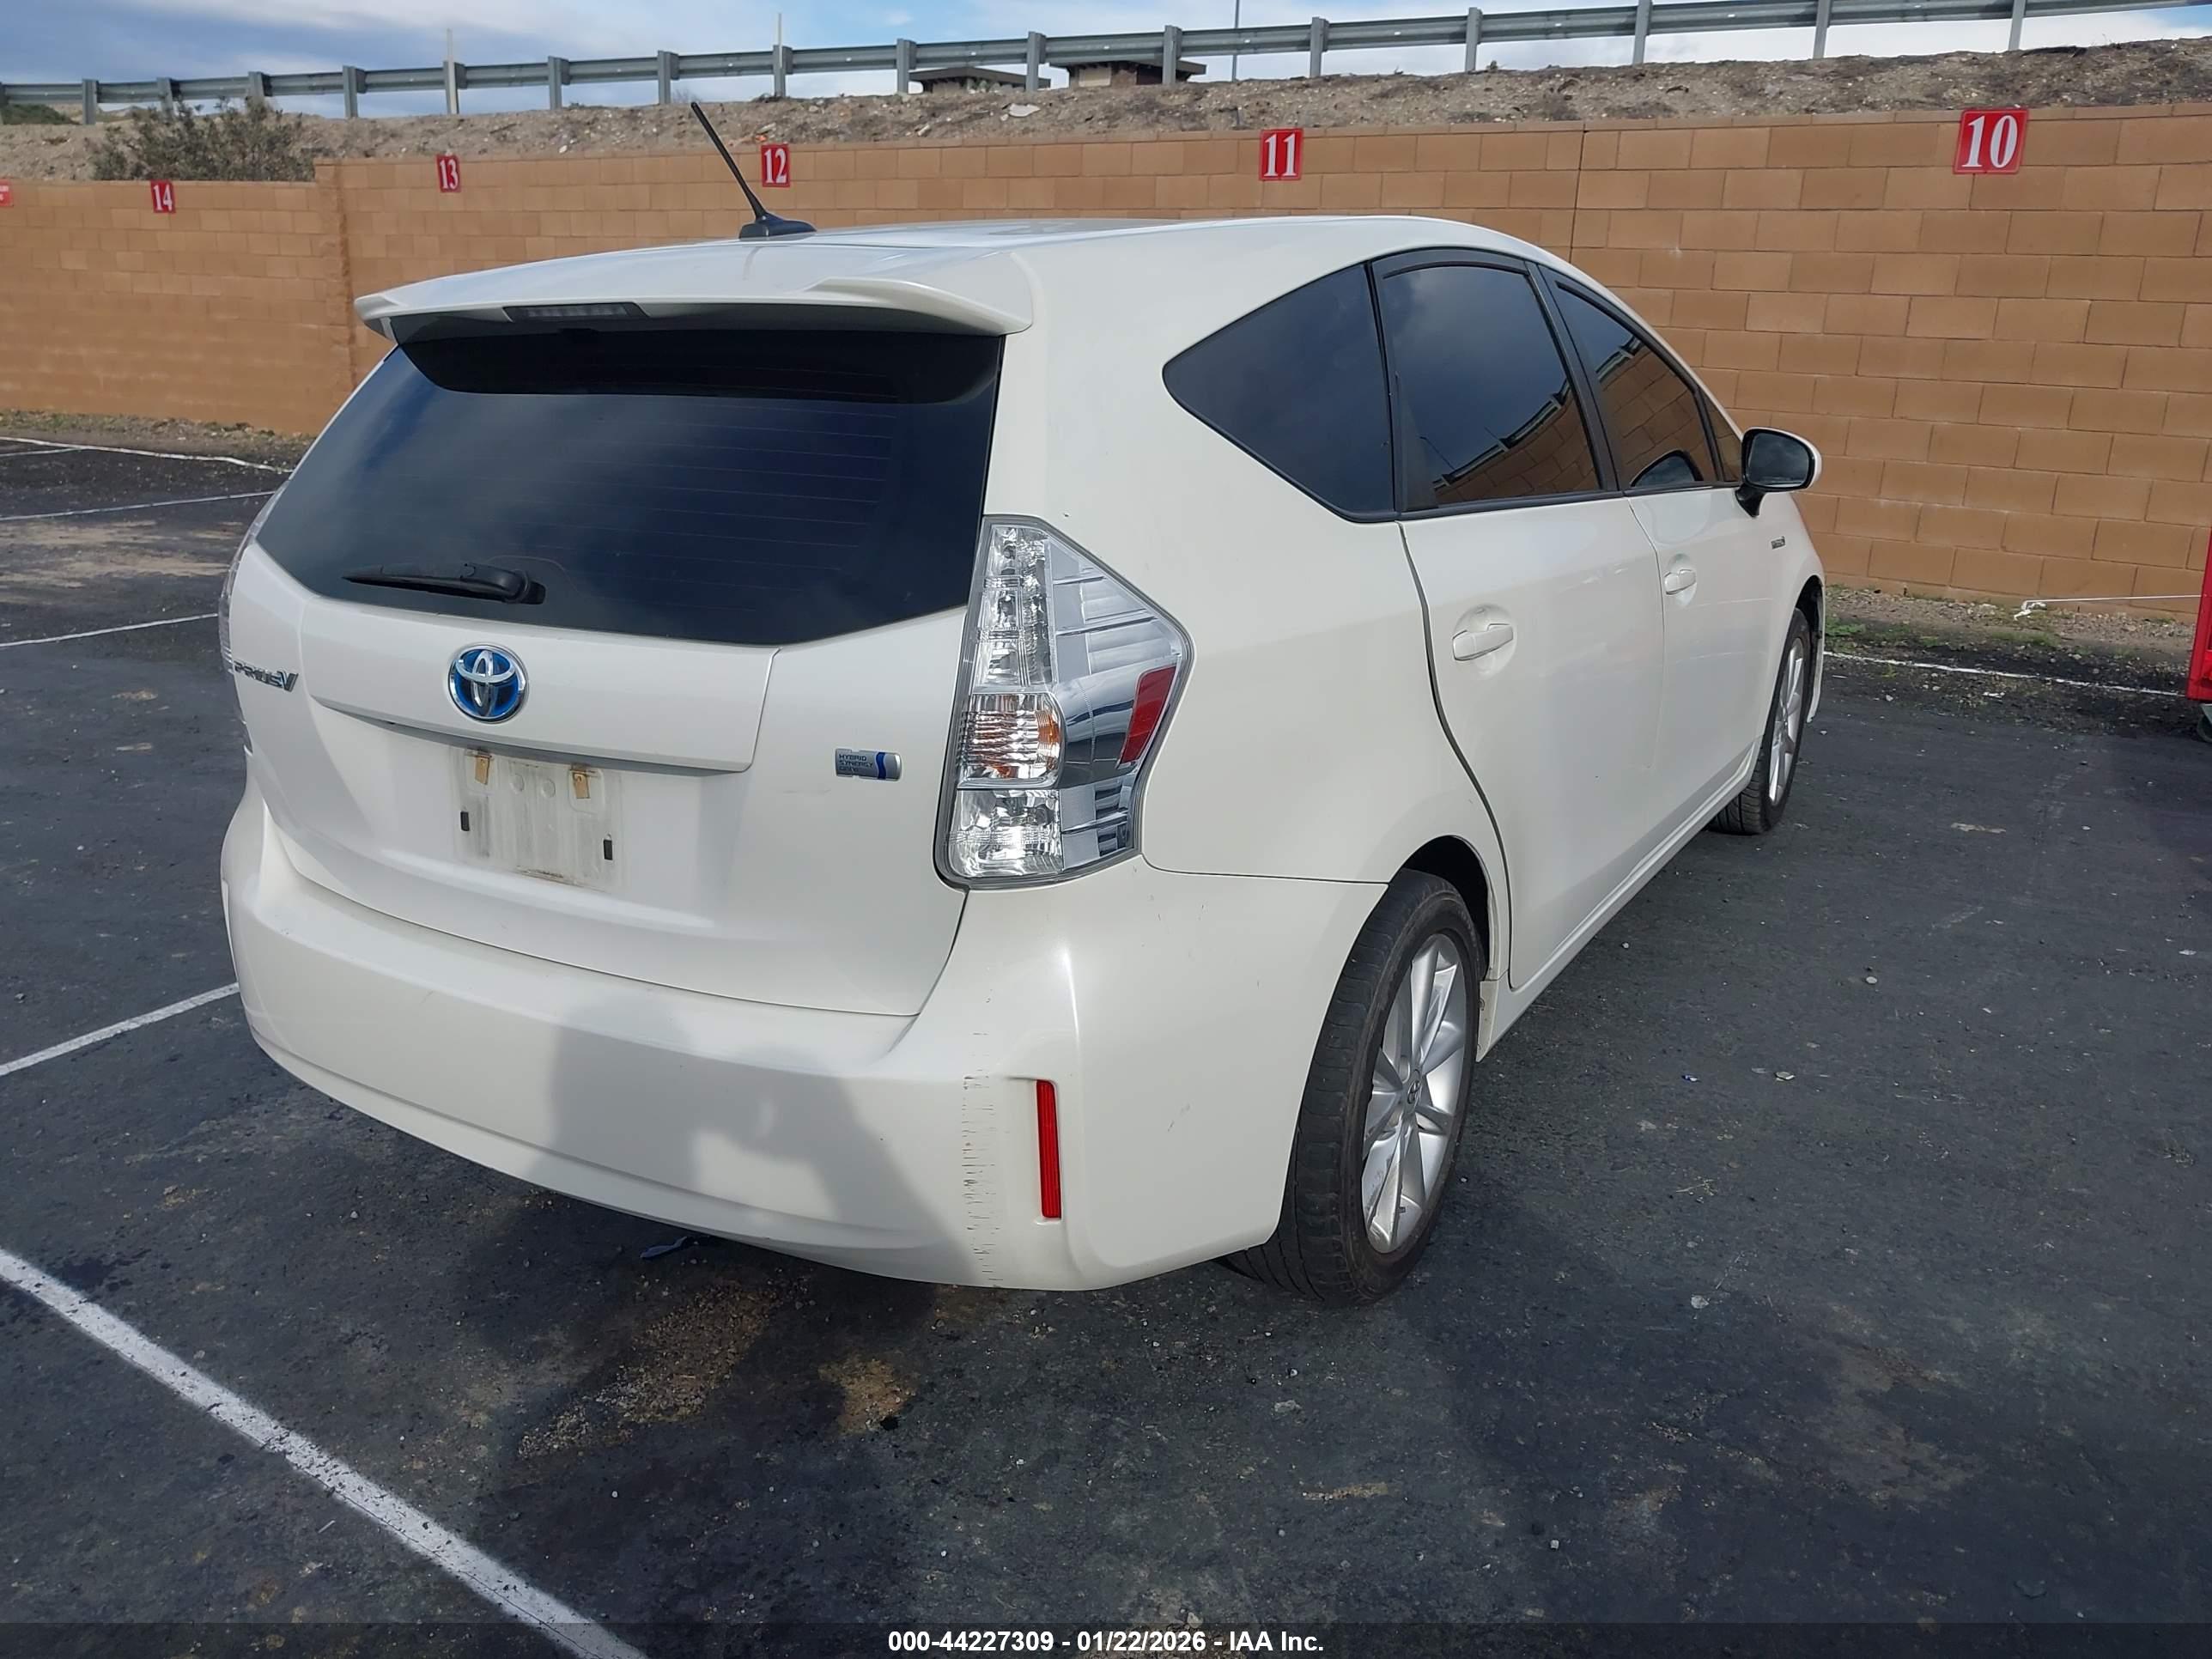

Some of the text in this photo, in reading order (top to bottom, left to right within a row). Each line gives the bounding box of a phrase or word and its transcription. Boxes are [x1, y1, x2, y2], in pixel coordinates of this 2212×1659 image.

[1264, 132, 1297, 177] 11
[1961, 115, 2018, 168] 10
[440, 159, 459, 189] 13
[764, 148, 787, 184] 12
[154, 184, 173, 211] 14
